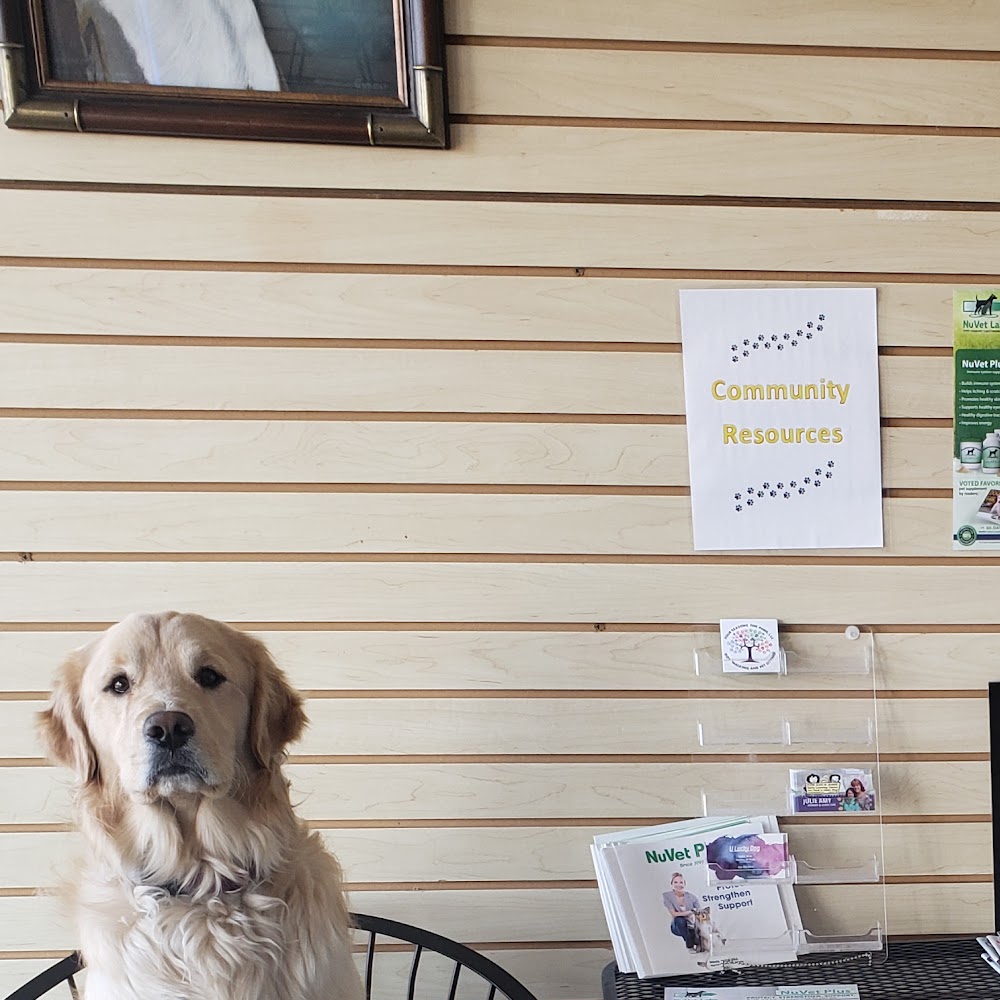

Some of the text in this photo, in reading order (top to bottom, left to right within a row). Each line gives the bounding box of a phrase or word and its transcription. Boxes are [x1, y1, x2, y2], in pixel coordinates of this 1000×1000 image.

[963, 320, 988, 329] NuVet
[961, 359, 989, 369] NuVet
[711, 378, 850, 404] Community
[722, 424, 844, 445] Resources
[802, 797, 818, 806] JULIE
[750, 845, 761, 853] Dog
[645, 847, 692, 864] NuVet
[702, 890, 751, 903] Strengthen
[718, 900, 754, 911] Support
